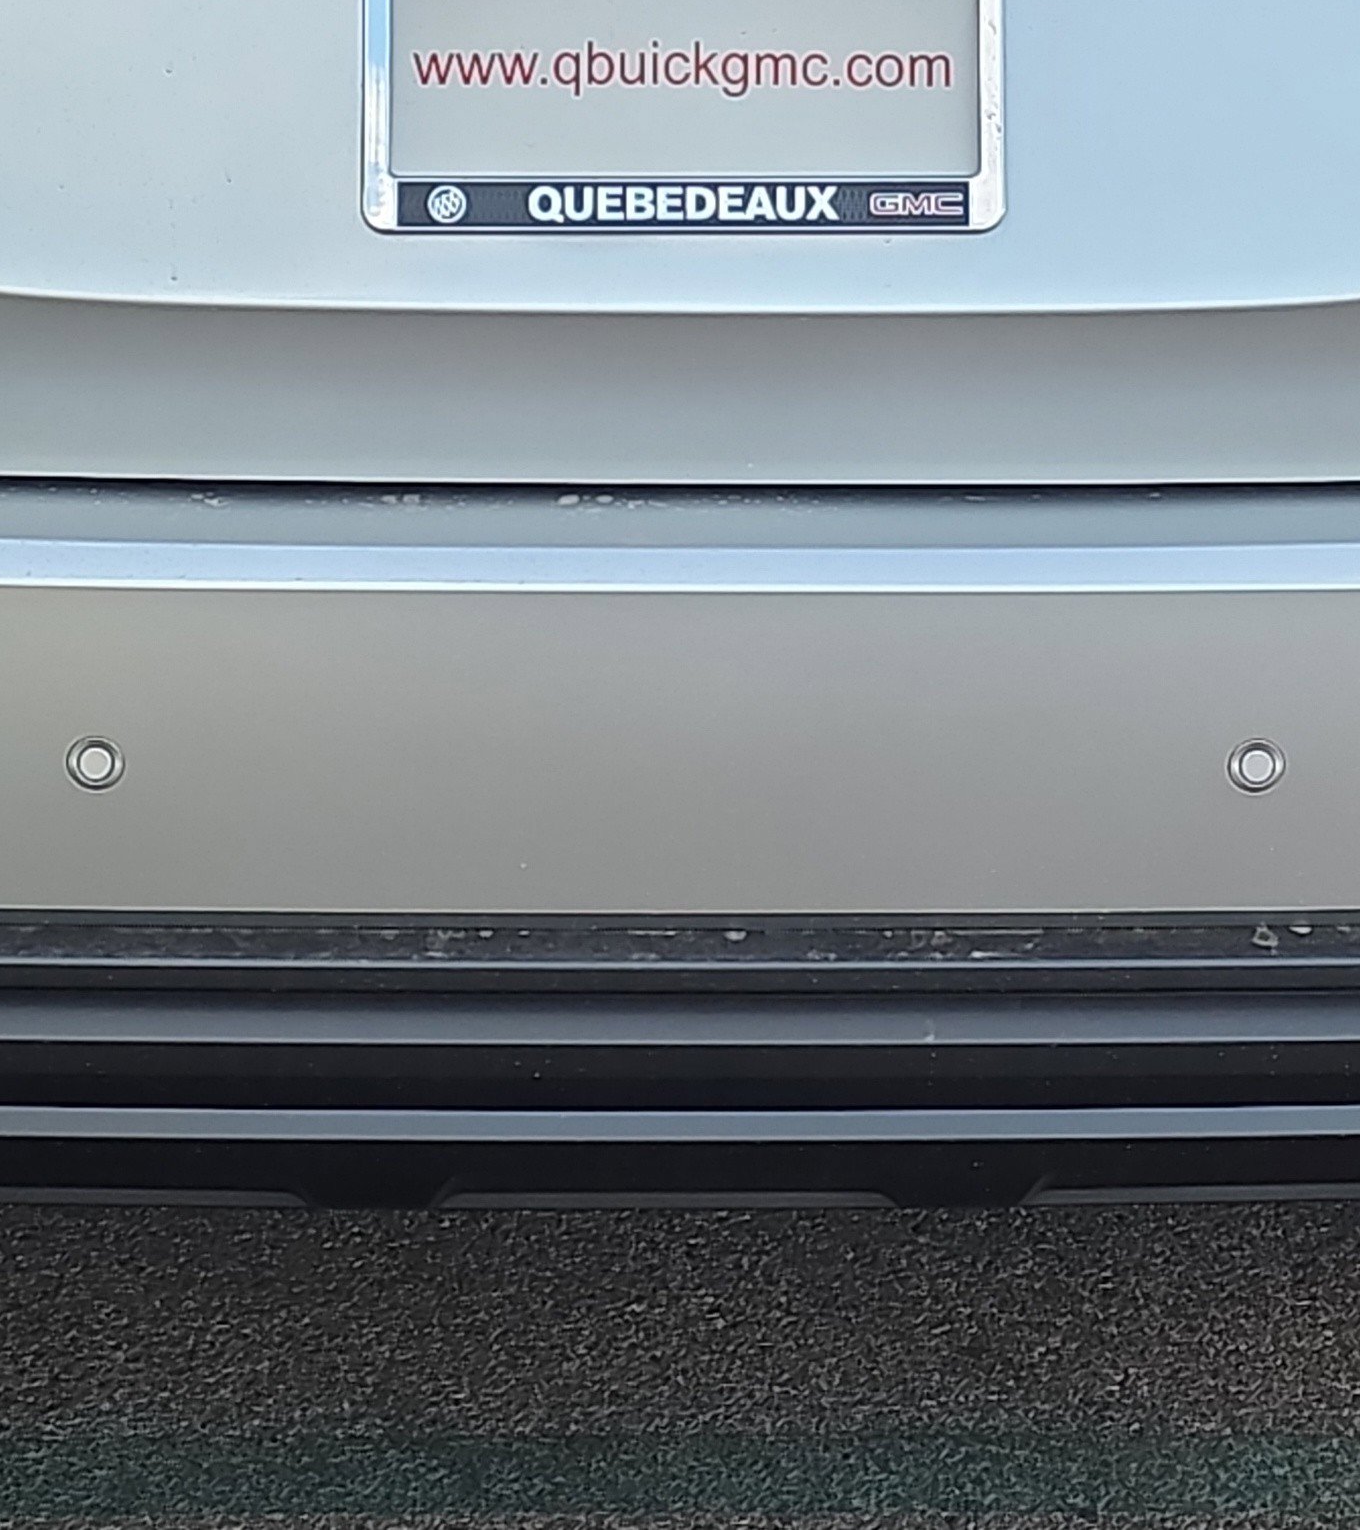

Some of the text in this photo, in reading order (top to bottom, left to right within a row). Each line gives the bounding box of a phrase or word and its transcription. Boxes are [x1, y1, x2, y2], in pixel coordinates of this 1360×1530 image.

[412, 41, 953, 97] www.qbuickgmc.com
[528, 185, 965, 224] QUEBEDEAUX GMC
